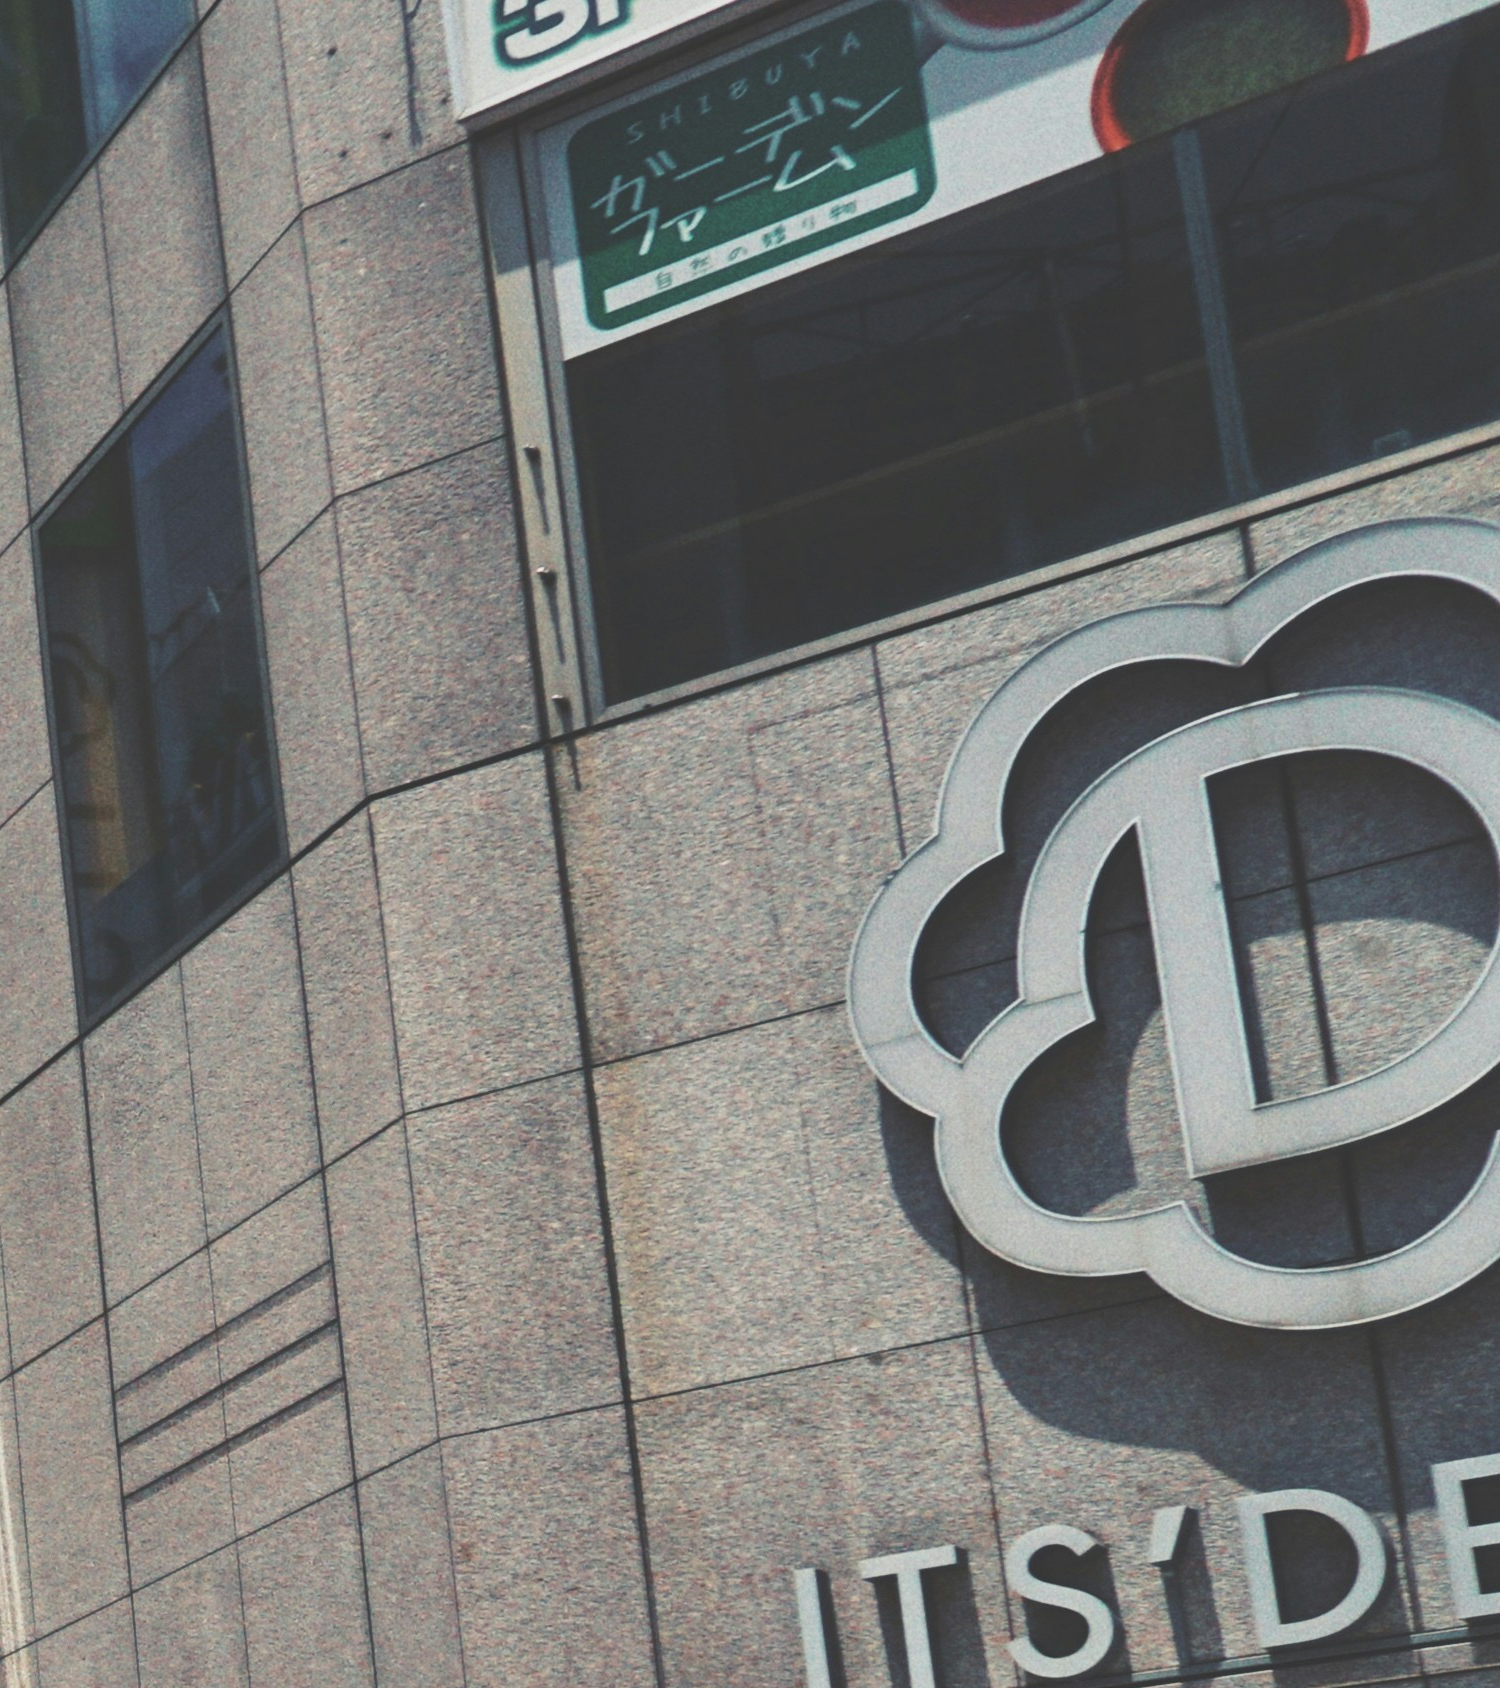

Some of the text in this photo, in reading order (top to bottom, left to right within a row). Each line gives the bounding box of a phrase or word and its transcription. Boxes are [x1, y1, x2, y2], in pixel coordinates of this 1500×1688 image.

[625, 30, 863, 144] SHIBUYA
[590, 85, 903, 218] ガーデン
[610, 146, 855, 256] ファーム
